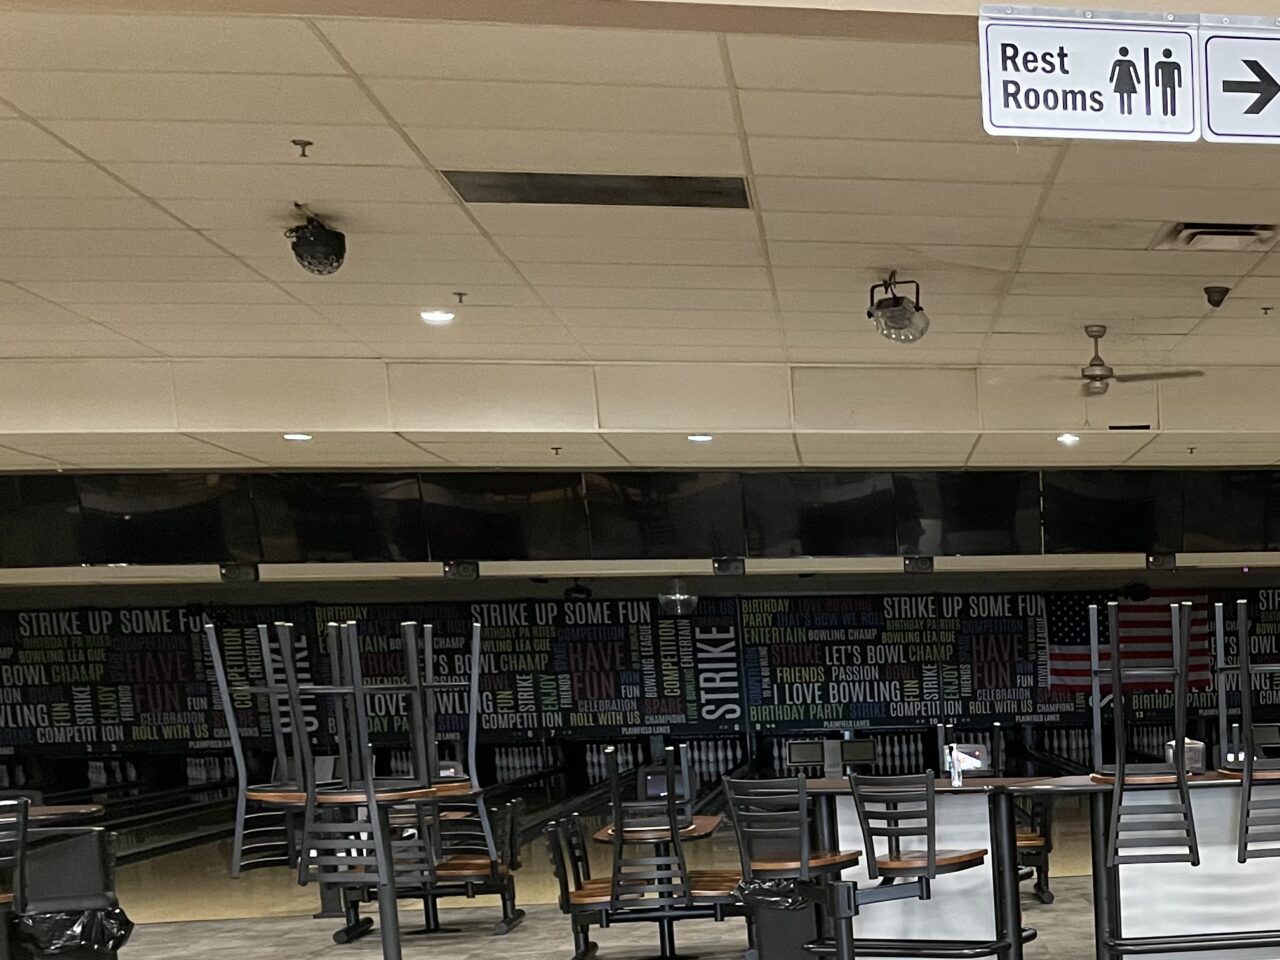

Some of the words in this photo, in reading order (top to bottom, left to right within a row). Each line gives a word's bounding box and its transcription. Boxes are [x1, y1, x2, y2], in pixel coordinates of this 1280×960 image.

[1000, 42, 1070, 75] Rest
[1002, 79, 1105, 113] Rooms
[470, 602, 529, 626] STRIKE
[535, 601, 558, 625] UP
[563, 600, 612, 625] SOME
[618, 600, 650, 624] FUN
[742, 599, 790, 614] BIRTHDAY
[883, 596, 936, 619] STRIKE
[942, 595, 963, 618] UP
[969, 595, 1015, 618] SOME
[18, 611, 81, 636] STRIKE
[88, 610, 112, 635] UP
[120, 609, 173, 634] SOME
[742, 613, 773, 627] PARTY
[433, 636, 466, 649] CHAMP
[638, 624, 654, 656] LEAGUE
[676, 618, 695, 668] ENTERTAIN
[744, 627, 807, 645] ENTERTAIN
[808, 629, 846, 641] BOWLING
[847, 628, 878, 641] CHAMP
[881, 631, 920, 644] BOWLING
[501, 652, 549, 672] CHAMP
[568, 641, 627, 672] HAVE
[658, 619, 681, 697] COMPETITION
[825, 645, 862, 666] LET'S
[867, 644, 907, 665] BOWL
[908, 644, 954, 663] CHAMP
[2, 664, 49, 686] BOWL
[50, 663, 105, 683] CHAMP
[641, 657, 658, 698] BOWLING
[694, 626, 742, 720] STRIKE
[776, 666, 825, 684] FRIENDS
[832, 665, 880, 682] PASSION
[922, 662, 941, 701] STRIKE
[943, 663, 960, 699] ENJOY
[959, 663, 973, 697] FRIENDS
[973, 661, 1012, 689] FUN
[1017, 674, 1034, 688] FUN
[516, 673, 537, 712] STRIKE
[538, 673, 559, 711] ENJOY
[557, 673, 574, 709] FRIENDS
[572, 671, 616, 700] FUN
[620, 685, 640, 699] FUN
[773, 683, 778, 705] I
[785, 682, 823, 705] LOVE
[829, 680, 901, 704] BOWLING
[903, 679, 921, 702] FUN
[977, 688, 1031, 701] CELEBRATION
[72, 684, 94, 726] STRIKE
[97, 685, 119, 725] ENJOY
[118, 684, 135, 722] FRIENDS
[187, 696, 208, 711] FUN
[366, 693, 408, 717] LOVE
[496, 690, 514, 713] FUN
[578, 699, 638, 713] CELEBRATION
[969, 701, 992, 715] ROLL
[994, 700, 1018, 714] WITH
[1020, 700, 1033, 713] US
[1036, 702, 1075, 713] CHAMPIONS
[1186, 692, 1218, 708] PARTY
[52, 703, 71, 727] FUN
[569, 712, 595, 727] ROLL
[597, 711, 624, 726] WITH
[627, 711, 641, 725] US
[644, 714, 686, 725] CHAMPIONS
[751, 704, 805, 721] BIRTHDAY
[809, 703, 845, 720] PARTY
[132, 726, 159, 741] ROLL
[161, 724, 190, 740] WITH
[194, 723, 210, 738] US
